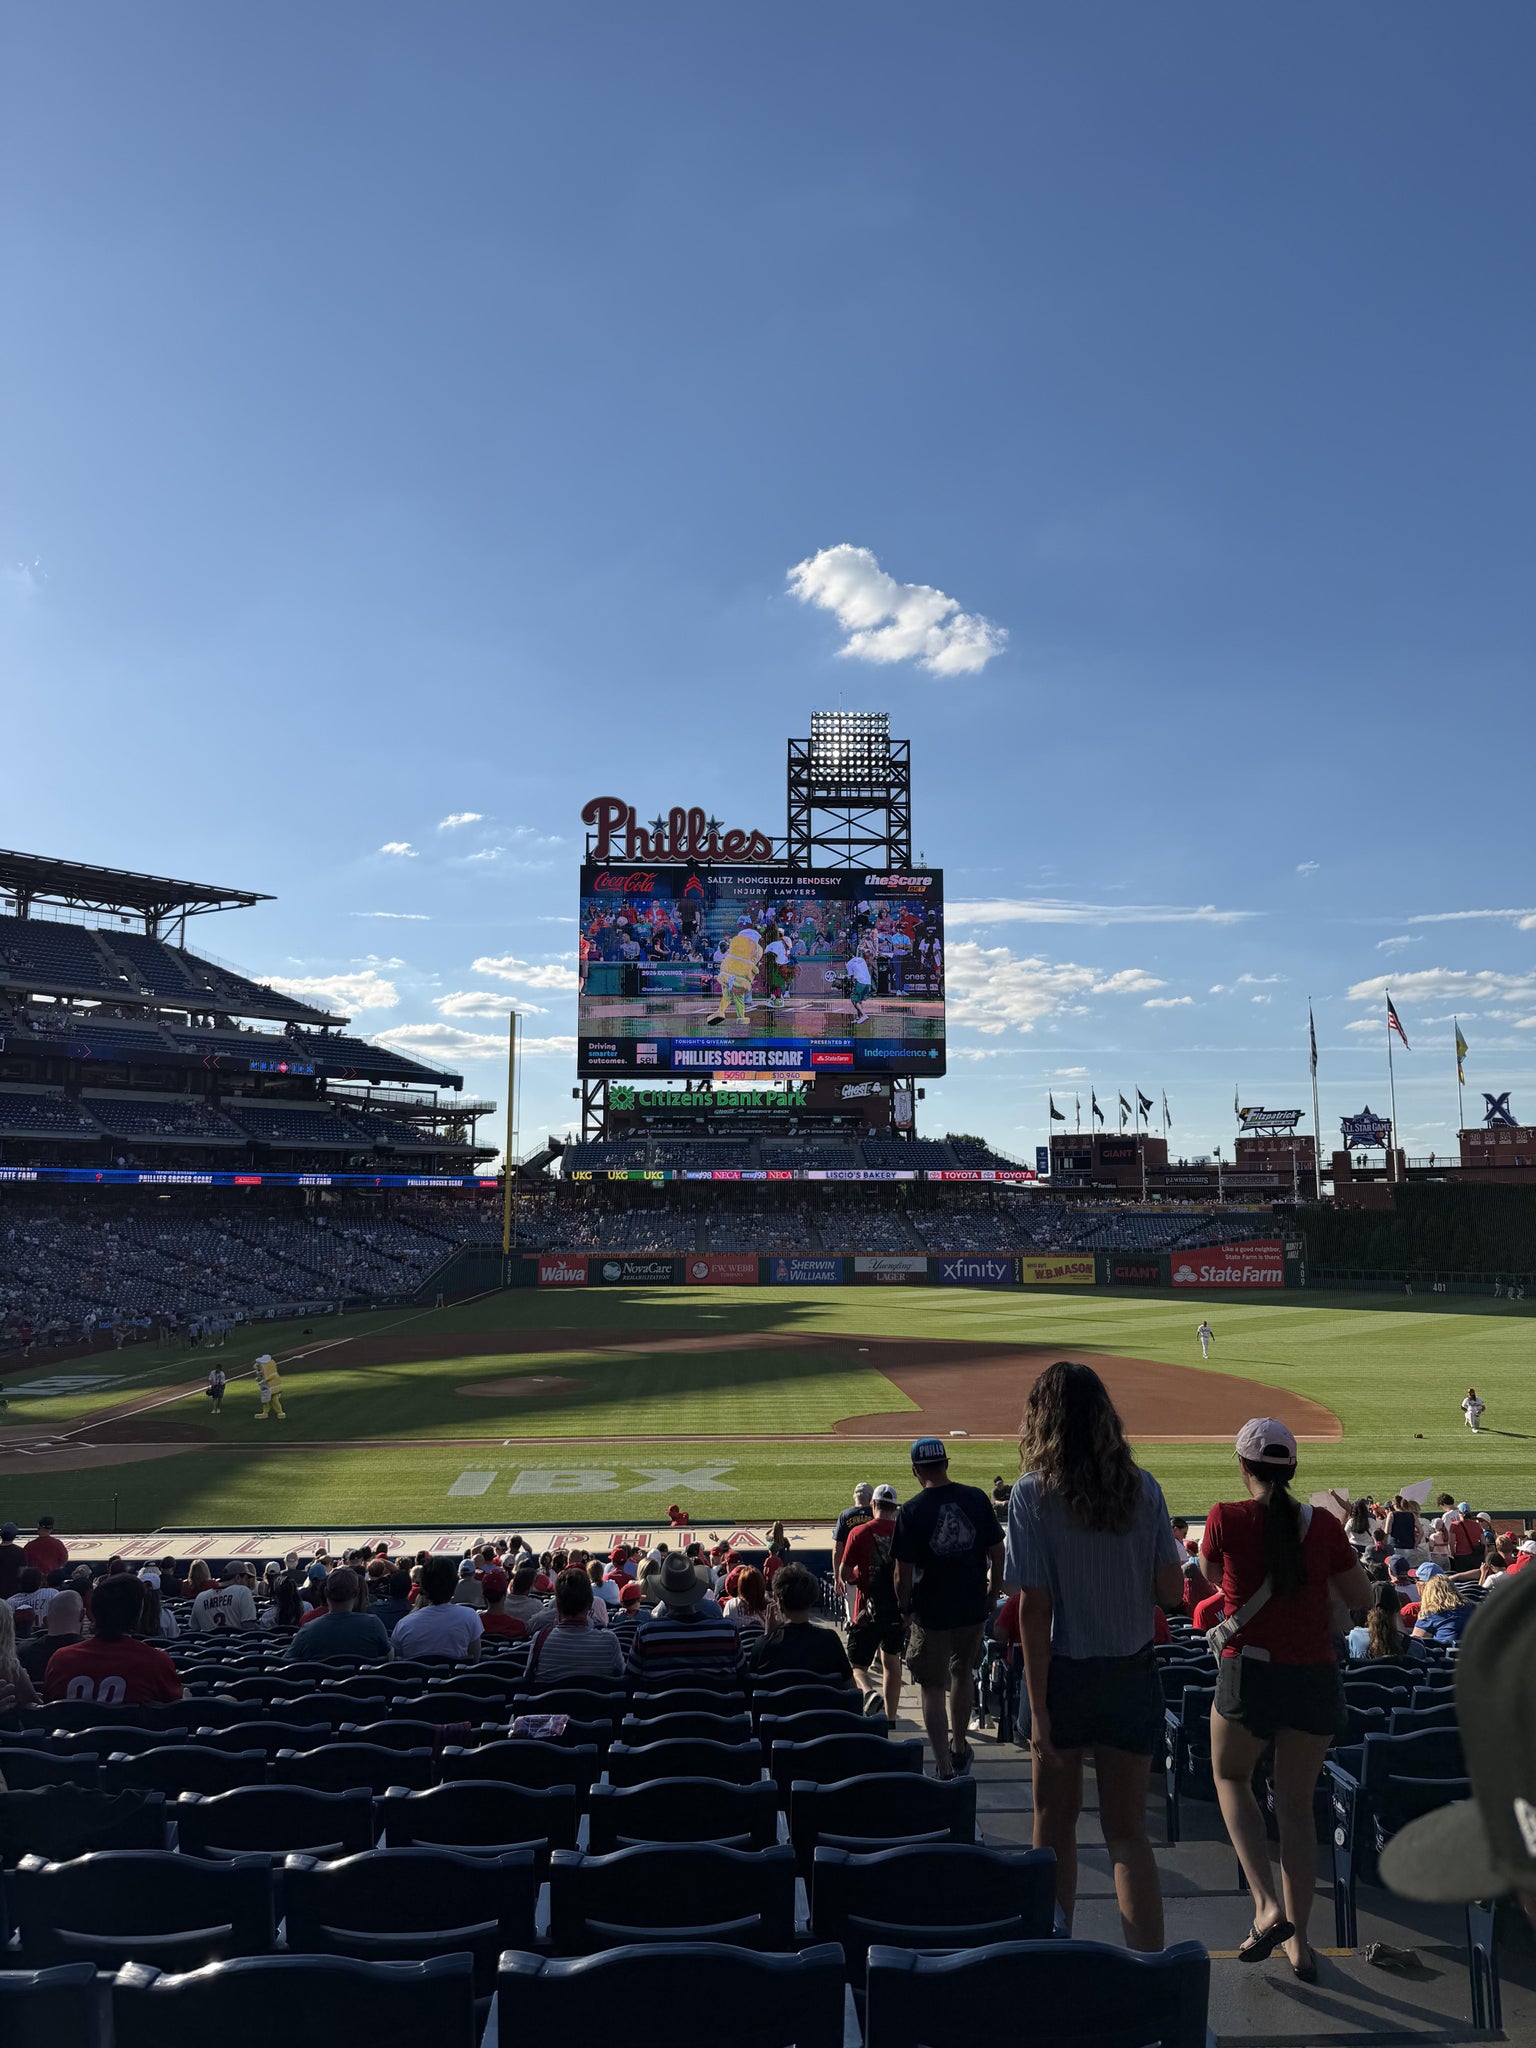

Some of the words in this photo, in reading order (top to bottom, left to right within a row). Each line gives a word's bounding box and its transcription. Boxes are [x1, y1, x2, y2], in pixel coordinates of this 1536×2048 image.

[581, 796, 772, 861] Phillies
[707, 876, 733, 884] SALTZ
[797, 877, 842, 885] BENDESKY
[864, 874, 933, 886] theScore
[588, 1043, 616, 1051] Driving
[864, 1048, 927, 1058] Independence
[674, 1050, 721, 1066] PHILLIES
[722, 1050, 766, 1066] SOCCER
[768, 1050, 803, 1066] SCARF
[639, 1089, 714, 1106] Citizens
[716, 1088, 761, 1106] Bank
[766, 1088, 807, 1106] Park
[1103, 1150, 1132, 1158] GIANT
[139, 1174, 167, 1183] PHILLIES
[168, 1175, 192, 1184] SOCCER
[571, 1171, 593, 1180] UKG
[607, 1171, 628, 1180] UKG
[643, 1171, 664, 1180] UKG
[715, 1171, 738, 1179] NECA
[769, 1171, 792, 1179] NECA
[825, 1171, 860, 1179] LISCIO'S
[863, 1171, 897, 1179] BAKERY
[944, 1171, 978, 1179] TOYOTA
[998, 1171, 1032, 1179] TOYOTA
[622, 1261, 673, 1274] NovaCare
[728, 1264, 754, 1273] WEBB
[790, 1259, 835, 1270] SHERWIN
[943, 1259, 1007, 1279] xfinity
[541, 1266, 585, 1281] Wawa
[876, 1273, 906, 1281] LAGER
[1115, 1267, 1158, 1278] GIANT
[1433, 1283, 1446, 1292] 401
[447, 1467, 740, 1496] IBX
[203, 1595, 232, 1611] HARPER
